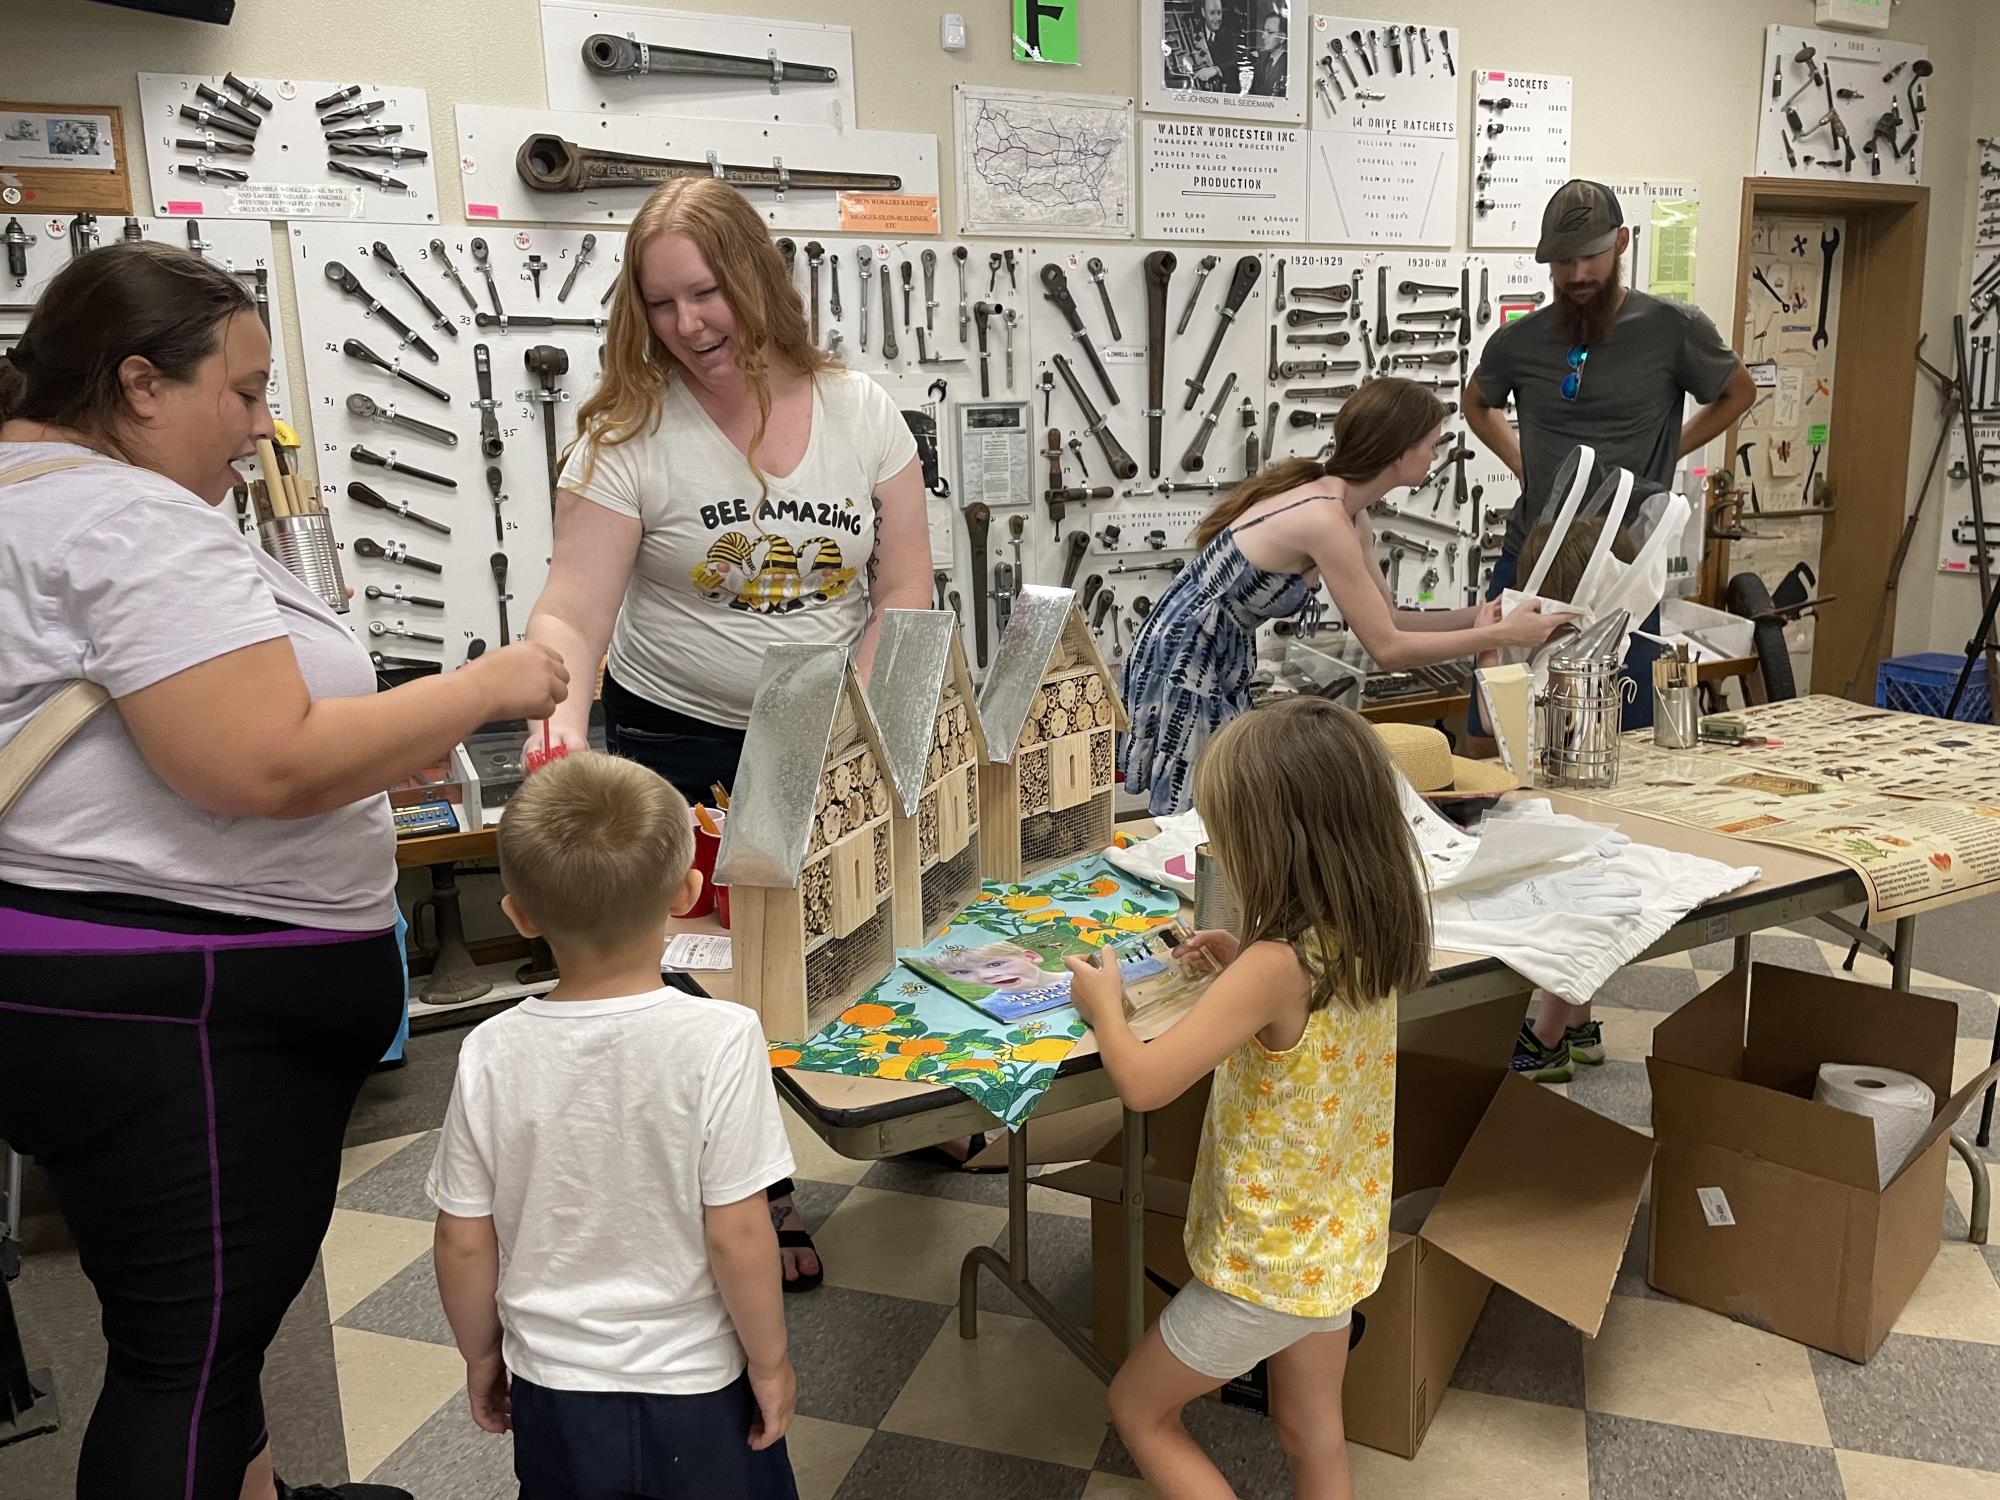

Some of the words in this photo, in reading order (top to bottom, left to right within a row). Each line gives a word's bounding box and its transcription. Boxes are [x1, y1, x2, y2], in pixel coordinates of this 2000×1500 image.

[1507, 77, 1549, 90] SOCKETS
[1173, 94, 1186, 102] JOE
[1188, 95, 1219, 105] JOHNSON
[1223, 98, 1237, 106] BILL
[1238, 99, 1275, 108] SEIDEMANN
[167, 104, 175, 117] 3
[1368, 117, 1397, 129] DRIVE
[1403, 120, 1454, 132] RATCHETS
[1158, 123, 1203, 136] WALDEN
[1208, 127, 1273, 142] WORCESTER
[1278, 131, 1297, 143] INC.
[163, 137, 170, 149] 4
[1153, 137, 1197, 145] TOMAHAWK
[1239, 143, 1285, 151] WORCESTER
[1190, 151, 1210, 159] TOOL
[168, 163, 174, 175] 5
[1154, 162, 1190, 170] STEVENS
[636, 167, 673, 179] WRENCH
[1193, 176, 1262, 189] PRODUCTION
[407, 190, 417, 200] 10
[1659, 186, 1683, 197] DRIVE
[871, 198, 900, 206] WORKERS
[93, 235, 100, 246] 9
[302, 245, 306, 259] 1
[358, 246, 369, 257] 2
[456, 243, 463, 253] 4
[559, 248, 568, 259] 5
[418, 249, 428, 260] 3
[614, 253, 620, 263] 6
[255, 258, 265, 267] 15
[1291, 255, 1343, 266] 1920-1929
[15, 277, 25, 288] 5
[460, 315, 471, 325] 33
[325, 342, 339, 353] 32
[324, 397, 334, 406] 31
[521, 407, 535, 421] 34
[502, 428, 518, 438] 35
[1974, 428, 2000, 439] DRIV
[324, 444, 337, 452] 30
[323, 485, 337, 494] 29
[700, 498, 751, 530] BEE
[505, 522, 518, 530] 36
[1004, 985, 1061, 1002] MASON
